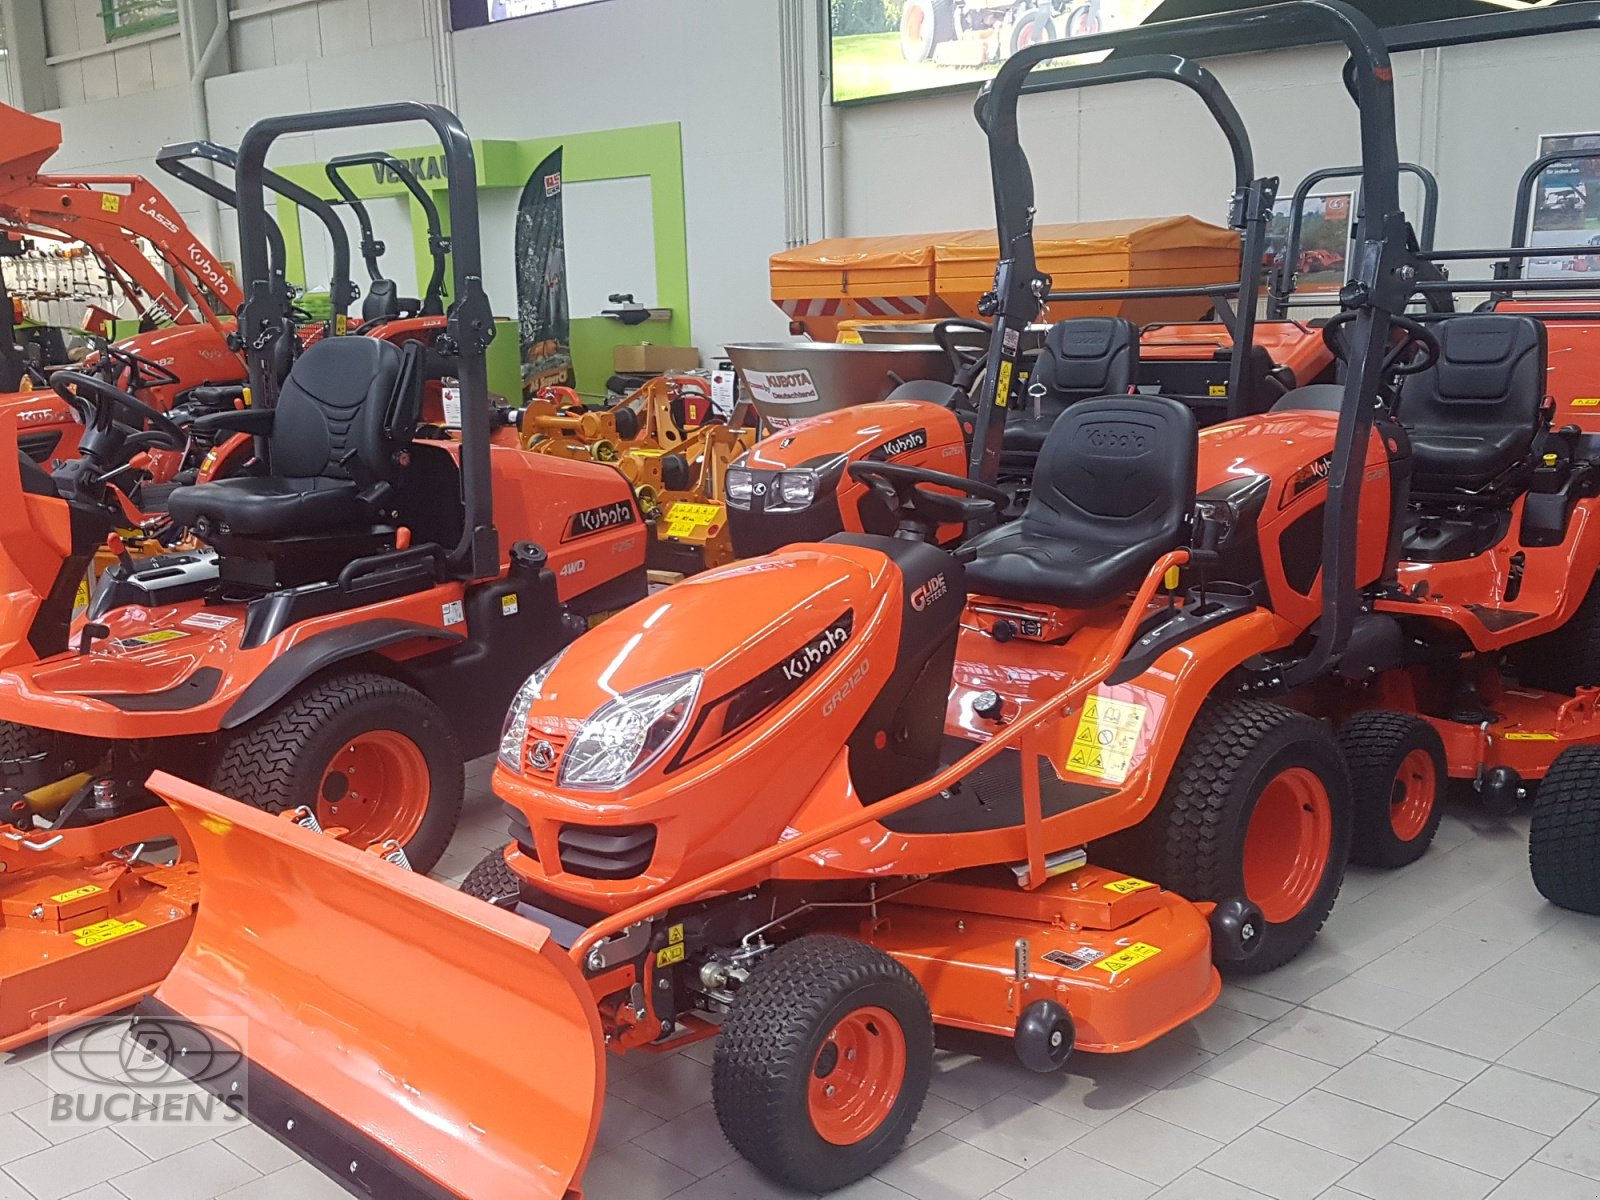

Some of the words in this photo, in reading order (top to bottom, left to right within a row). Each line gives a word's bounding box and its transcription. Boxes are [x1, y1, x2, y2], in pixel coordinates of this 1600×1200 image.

[372, 155, 448, 184] VEKAU
[139, 203, 179, 233] LA525
[187, 243, 228, 295] Kubota
[766, 373, 811, 388] KUBOTA
[772, 389, 816, 400] Deutschland
[883, 434, 925, 455] Kubota
[1085, 429, 1145, 449] Kubota
[1310, 457, 1332, 477] Kub
[581, 503, 630, 530] Kubota
[559, 559, 586, 576] 4WD
[910, 572, 947, 612] GLIDE
[925, 585, 948, 607] STEER
[782, 627, 848, 681] Kubota
[822, 658, 870, 718] GR2120
